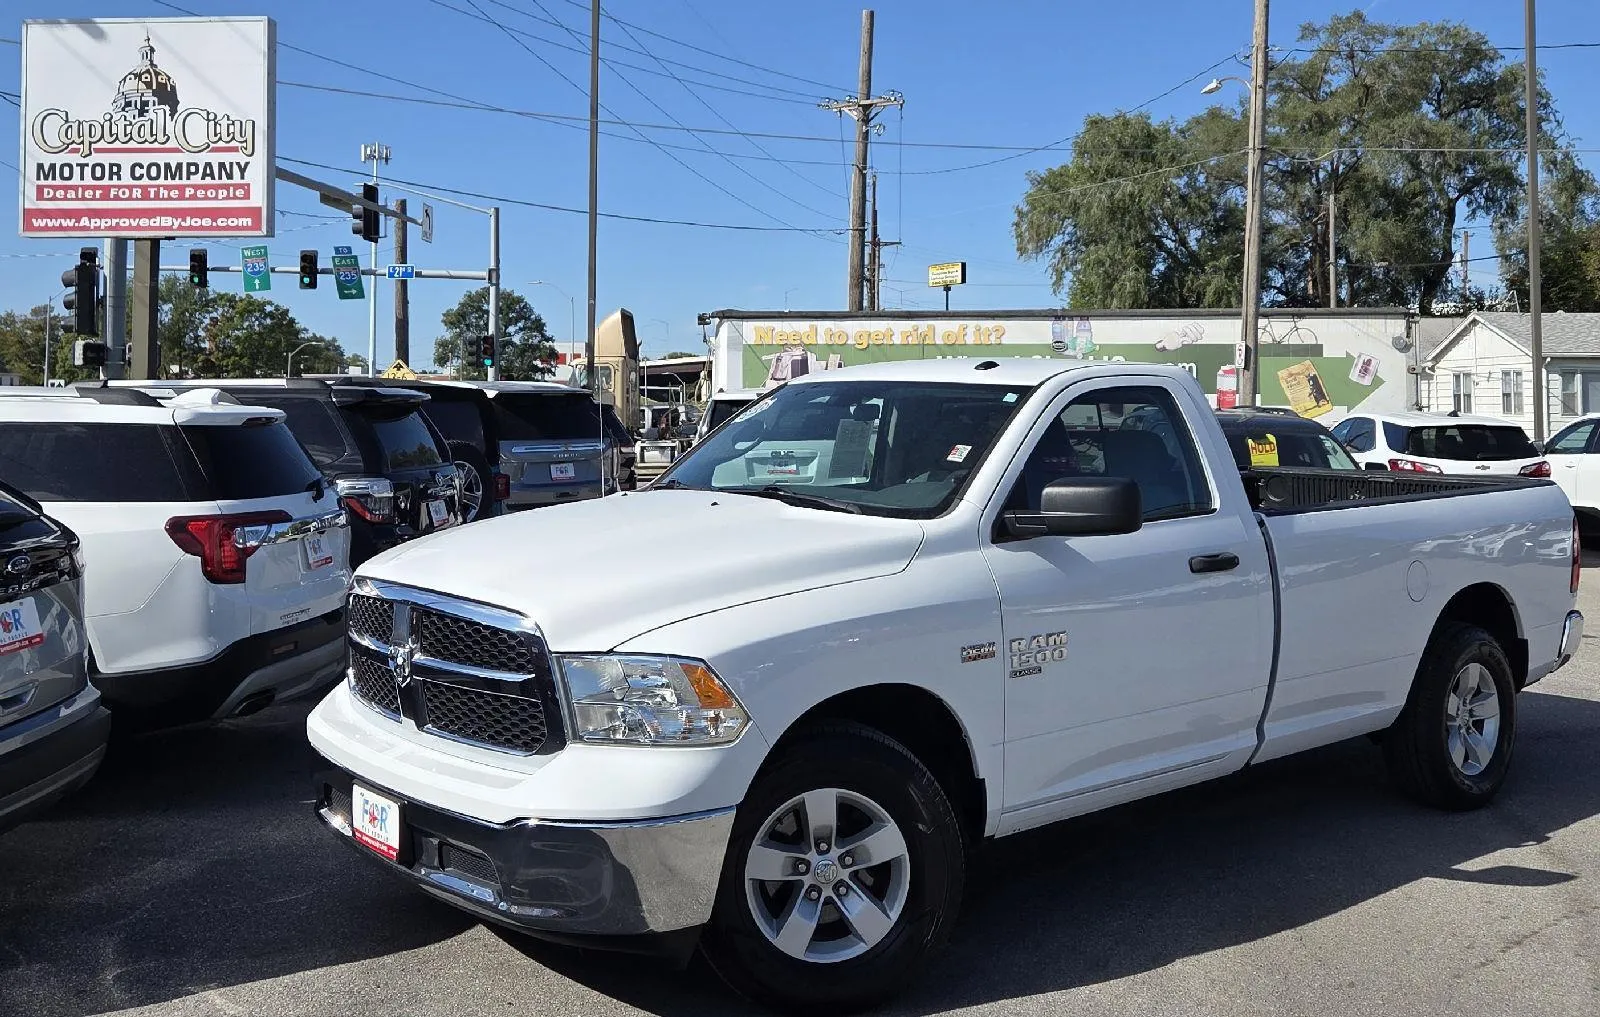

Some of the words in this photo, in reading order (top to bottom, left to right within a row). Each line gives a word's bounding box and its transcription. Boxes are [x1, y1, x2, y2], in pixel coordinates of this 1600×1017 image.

[32, 108, 170, 158] Capital
[174, 108, 255, 157] City
[36, 163, 122, 181] MOTOR
[130, 161, 250, 181] COMPANY
[43, 187, 102, 199] Dealer
[110, 187, 142, 199] FOR
[148, 186, 180, 199] The
[31, 216, 253, 230] www.ApprovedByJoe.com
[246, 262, 266, 273] 235
[339, 271, 358, 281] 235
[754, 325, 818, 345] Need
[824, 327, 848, 345] to
[854, 326, 894, 349] get
[901, 324, 936, 345] rid
[942, 324, 967, 345] of
[973, 324, 1005, 345] it?
[1250, 442, 1276, 455] HOLD
[1009, 630, 1069, 653] RAM
[1010, 647, 1068, 669] 1500
